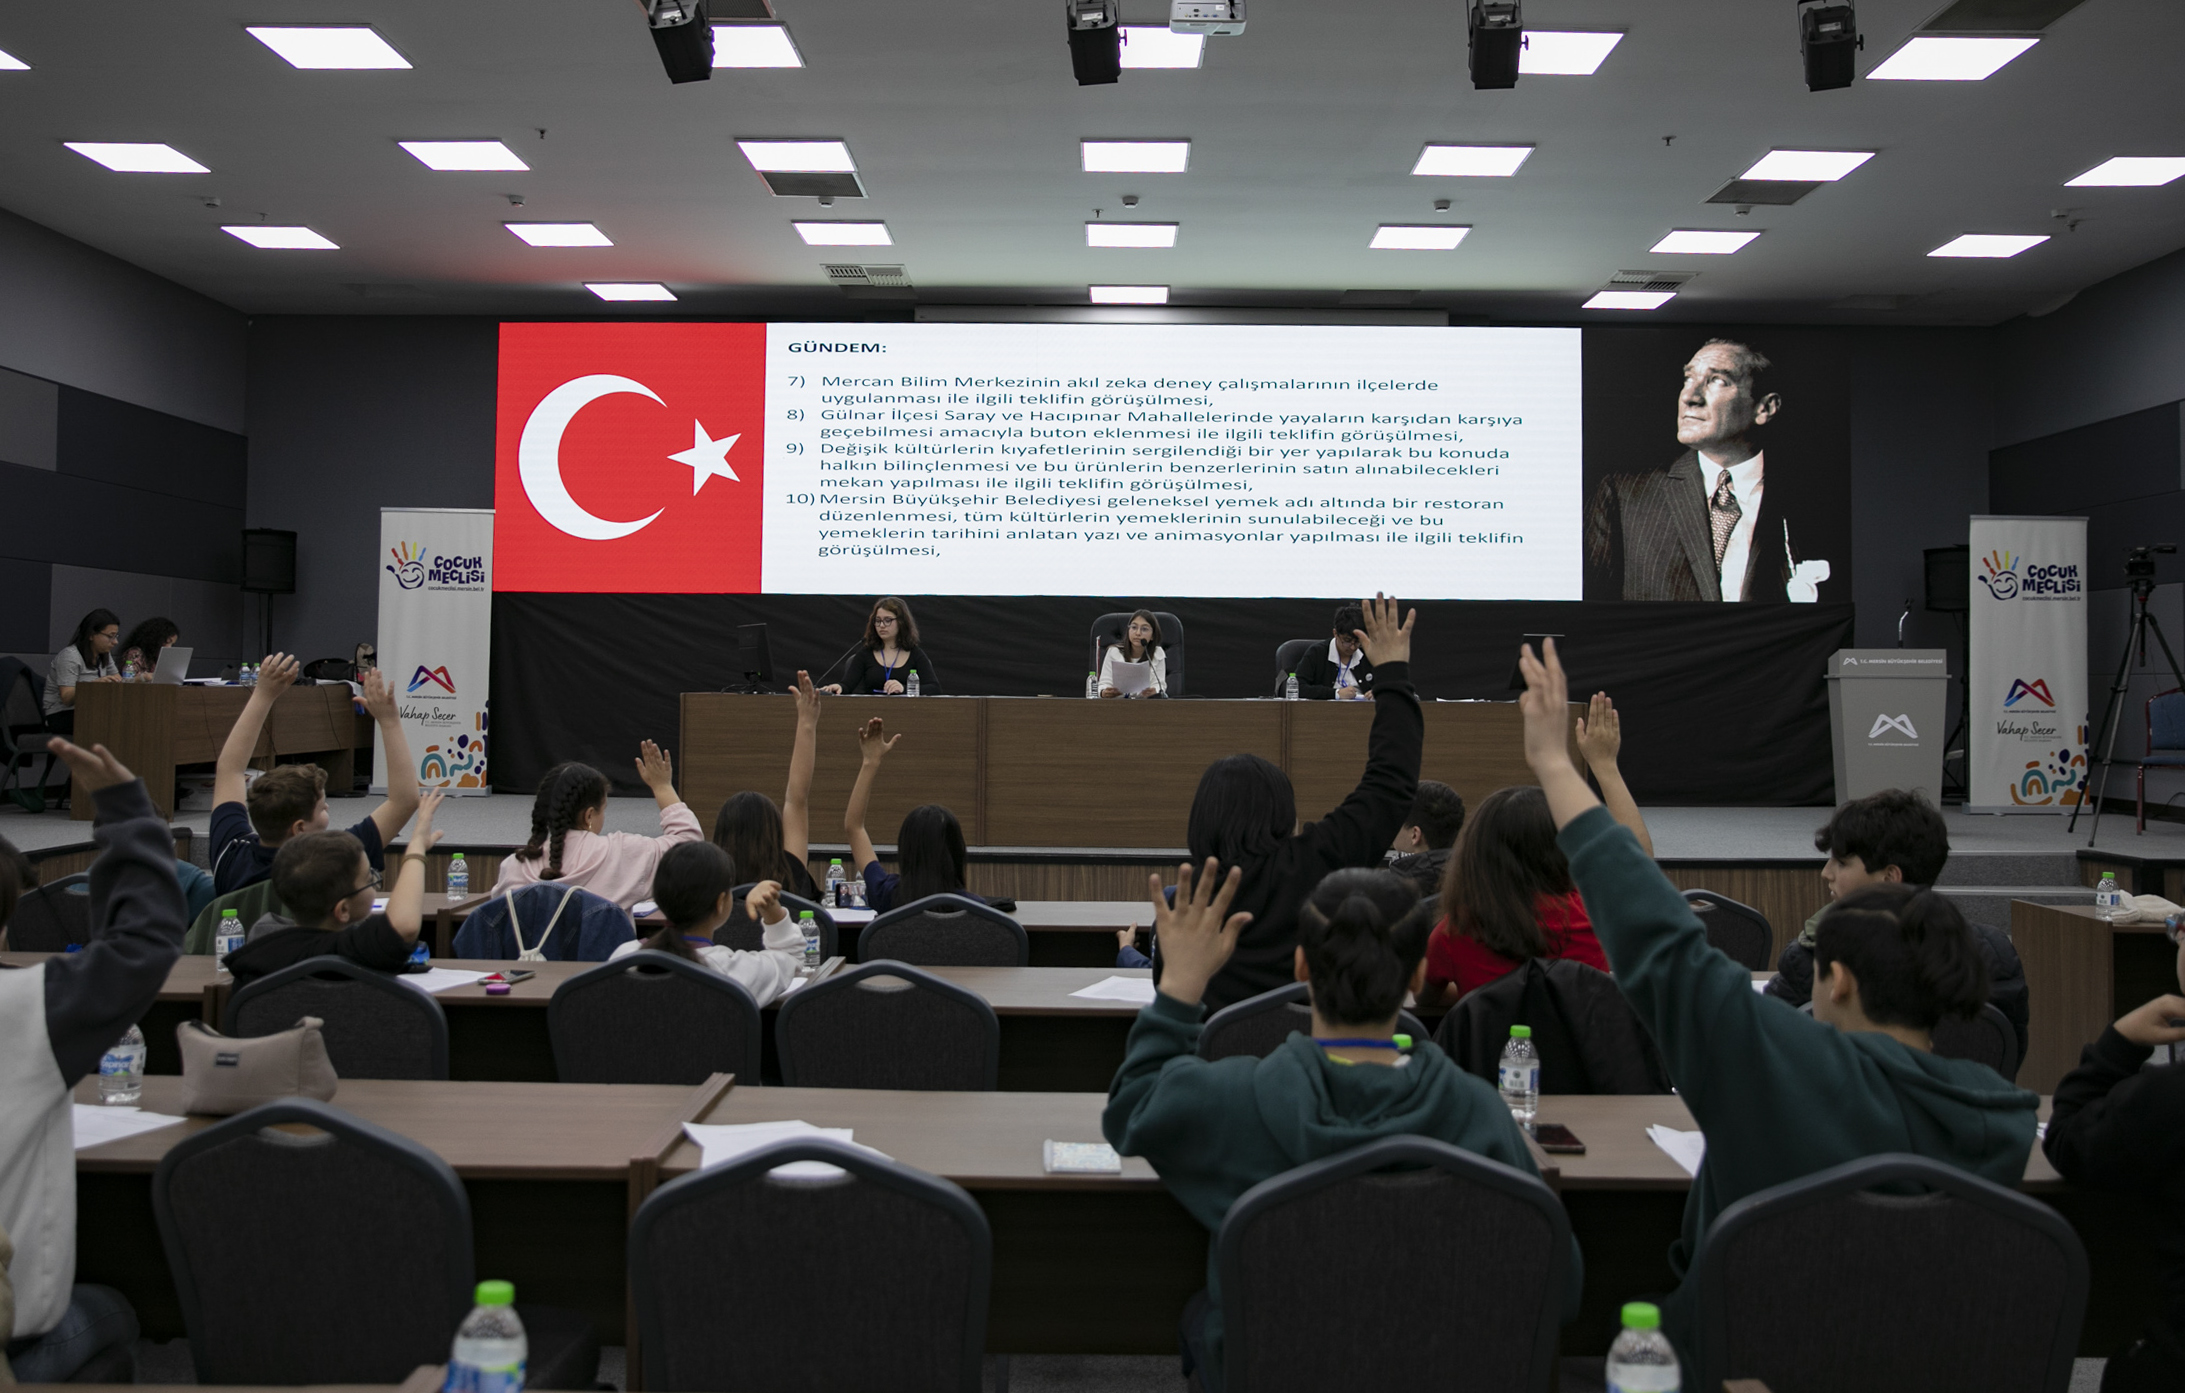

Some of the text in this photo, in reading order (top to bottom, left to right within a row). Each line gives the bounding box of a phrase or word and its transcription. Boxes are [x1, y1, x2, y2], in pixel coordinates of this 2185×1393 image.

[788, 340, 887, 353] GÜNDEM:
[788, 375, 1439, 393] 7) Mercan Bilim Merkezinin akıl zeka deney çalışmalarının ilçelerde
[821, 392, 1213, 408] uygulanması ile ilgili teklifin görüşülmesi,
[786, 407, 1523, 428] 8) Gülnar İlçesi Saray ve Hacıpınar Mahallelerinde yayaların karşıdan karşıya
[820, 426, 1463, 444] geçebilmesi amacıyla buton eklenmesi ile ilgili teklifin görüşülmesi,
[786, 442, 1510, 460] 9) Değişik kültürlerin kıyafetlerinin sergilendiği bir yer yapılarak bu konuda
[820, 459, 1499, 476] halkın bilinçlenmesi ve bu ürünlerin benzerlerinin satın alınabilecekleri
[820, 476, 1253, 492] mekan yapılması ile ilgili teklifin görüşülmesi,
[786, 492, 1504, 510] 10) Mersin Büyükşehir Belediyesi geleneksel yemek adı altında bir restoran
[819, 510, 1443, 528] düzenlenmesi, tüm kültürlerin yemeklerinin sunulabileceği ve bu
[818, 527, 1524, 546] yemeklerin tarihini anlatan yazı ve animasyonlar yapılması ile ilgili teklifin
[818, 544, 941, 558] görüşülmesi,
[433, 555, 483, 571] ÇOCUK
[2027, 564, 2078, 580] ÇOCUK
[399, 705, 430, 726] Vahap
[431, 706, 457, 721] Seçer
[1997, 720, 2029, 741] Vahap
[2030, 721, 2057, 736] Seçer
